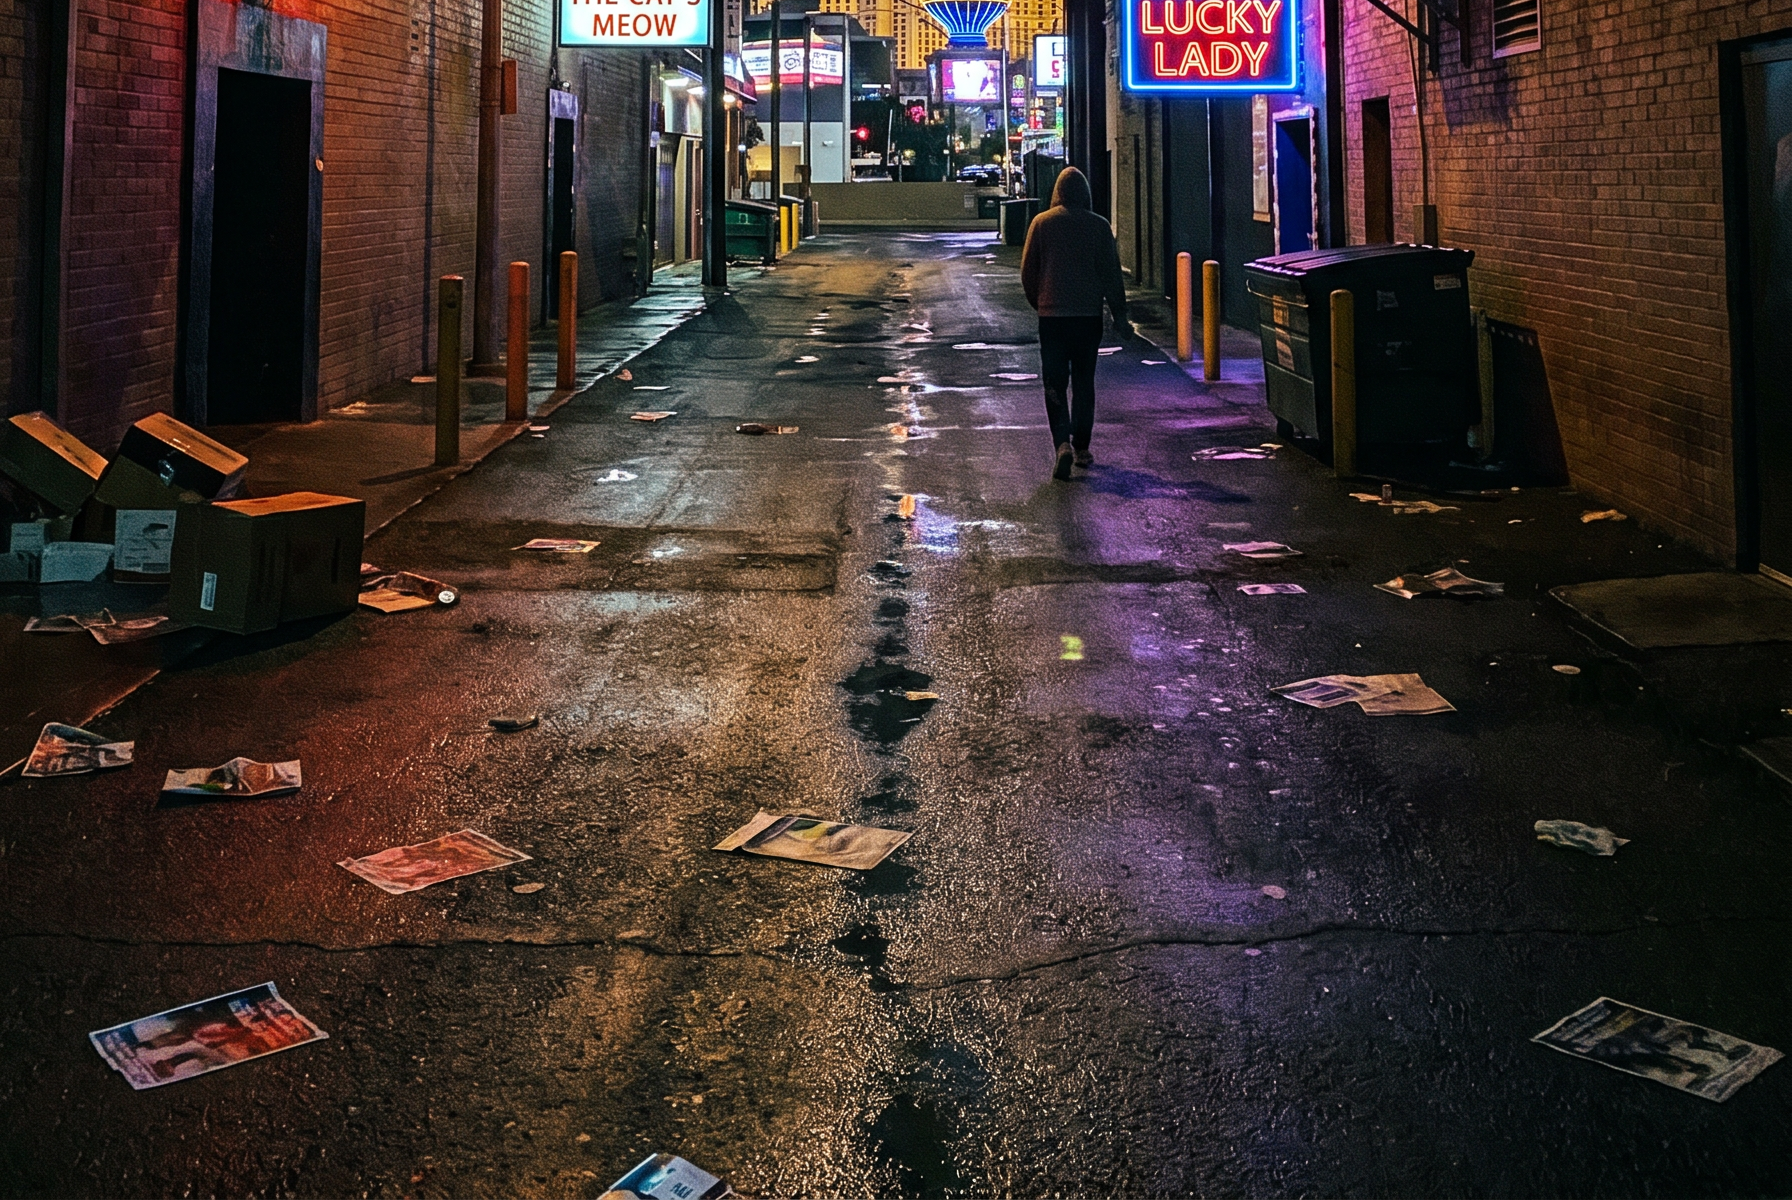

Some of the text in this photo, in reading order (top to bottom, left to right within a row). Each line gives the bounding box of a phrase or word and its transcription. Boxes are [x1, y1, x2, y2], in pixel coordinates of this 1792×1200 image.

[592, 12, 678, 37] MEOW
[1141, 0, 1281, 35] LUCKY
[1154, 41, 1269, 77] LADY
